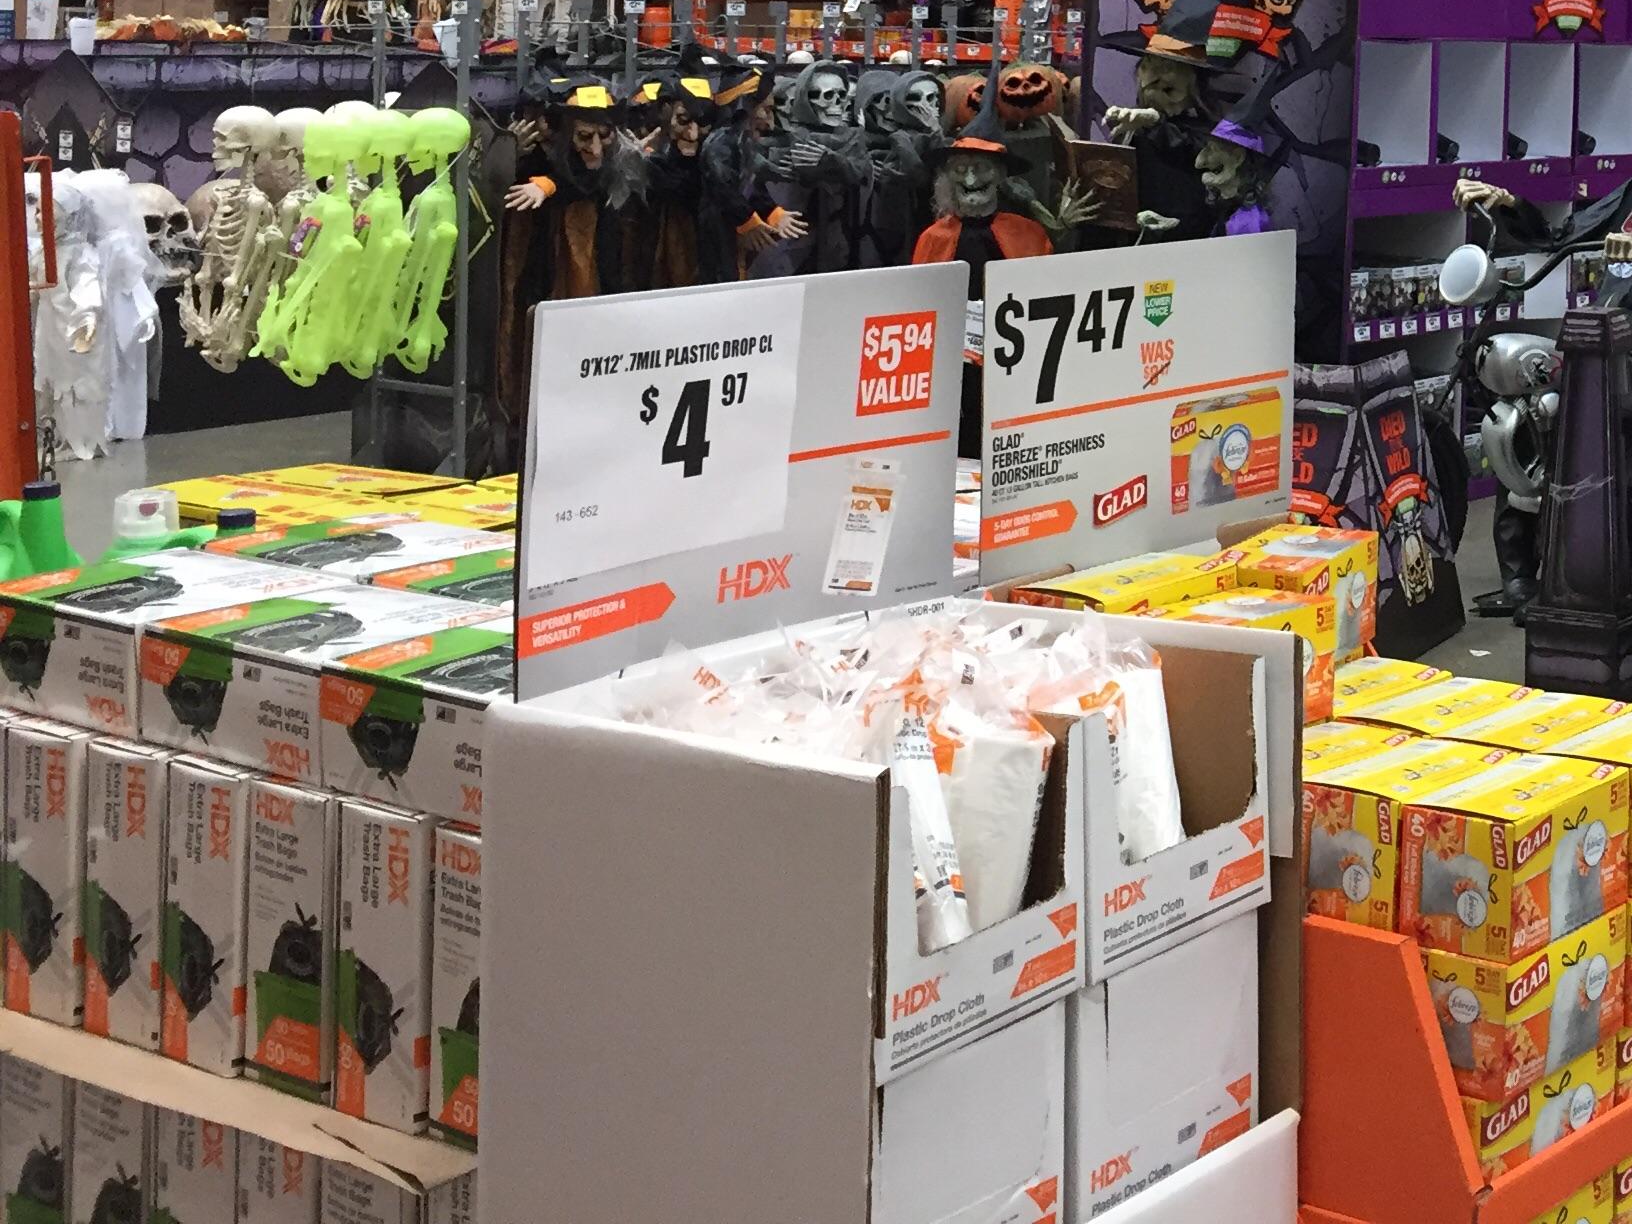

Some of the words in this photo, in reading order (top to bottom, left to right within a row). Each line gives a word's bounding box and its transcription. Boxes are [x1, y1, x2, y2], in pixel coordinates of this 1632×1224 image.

[1145, 296, 1171, 307] LOWER
[1150, 283, 1168, 294] NEW
[1147, 305, 1169, 317] PRICE
[664, 341, 720, 367] PLASTIC
[722, 336, 756, 359] DROP
[759, 334, 773, 353] CL
[1140, 338, 1175, 364] WAS
[861, 372, 930, 407] VALUE
[993, 433, 1022, 452] GLAD
[1172, 420, 1196, 440] GLAD
[992, 446, 1040, 470] FEBREZE
[1045, 433, 1105, 459] FRESHNESS
[992, 460, 1060, 487] ODORSHIELD
[1032, 508, 1059, 523] CONTROL
[1097, 482, 1145, 521] GLAD
[717, 553, 793, 605] HDX
[1275, 576, 1284, 590] 5
[532, 612, 572, 634] SUPERIOR
[574, 601, 619, 622] PROTECTION
[1316, 608, 1325, 626] 5
[532, 625, 581, 649] VERSATILITY
[264, 738, 310, 776] HDX
[46, 746, 66, 820] HDX
[126, 764, 146, 839] HDX
[1610, 784, 1618, 804] 5
[210, 786, 231, 861] HDX
[256, 790, 296, 825] HDX
[1377, 801, 1391, 844] GLAD
[1409, 813, 1425, 838] 40
[363, 822, 372, 863] Trash
[373, 823, 382, 862] Extra
[442, 840, 482, 877] HDX
[1491, 826, 1507, 868] GLAD
[1516, 822, 1550, 864] GLAD
[388, 826, 409, 905] HDX
[360, 866, 371, 903] Bags
[371, 866, 381, 909] Large
[1104, 877, 1146, 917] HDX
[1104, 919, 1135, 942] Plastic
[1137, 909, 1159, 928] Drop
[1161, 897, 1184, 916] Cloth
[1374, 901, 1389, 913] 5
[1491, 927, 1507, 939] 5
[1609, 917, 1617, 938] 5
[1475, 967, 1486, 985] 5
[1509, 960, 1548, 1007] GLAD
[893, 976, 941, 1022] HDX
[892, 1022, 928, 1046] Plastic
[931, 1008, 956, 1028] Drop
[958, 993, 985, 1014] Cloth
[452, 1100, 474, 1128] 50
[1485, 1093, 1529, 1142] GLAD
[282, 1145, 303, 1196] DX
[1090, 1150, 1133, 1194] HDX
[1092, 1192, 1122, 1216] Plastic
[1124, 1178, 1146, 1200] Drop
[1148, 1163, 1172, 1184] Cloth
